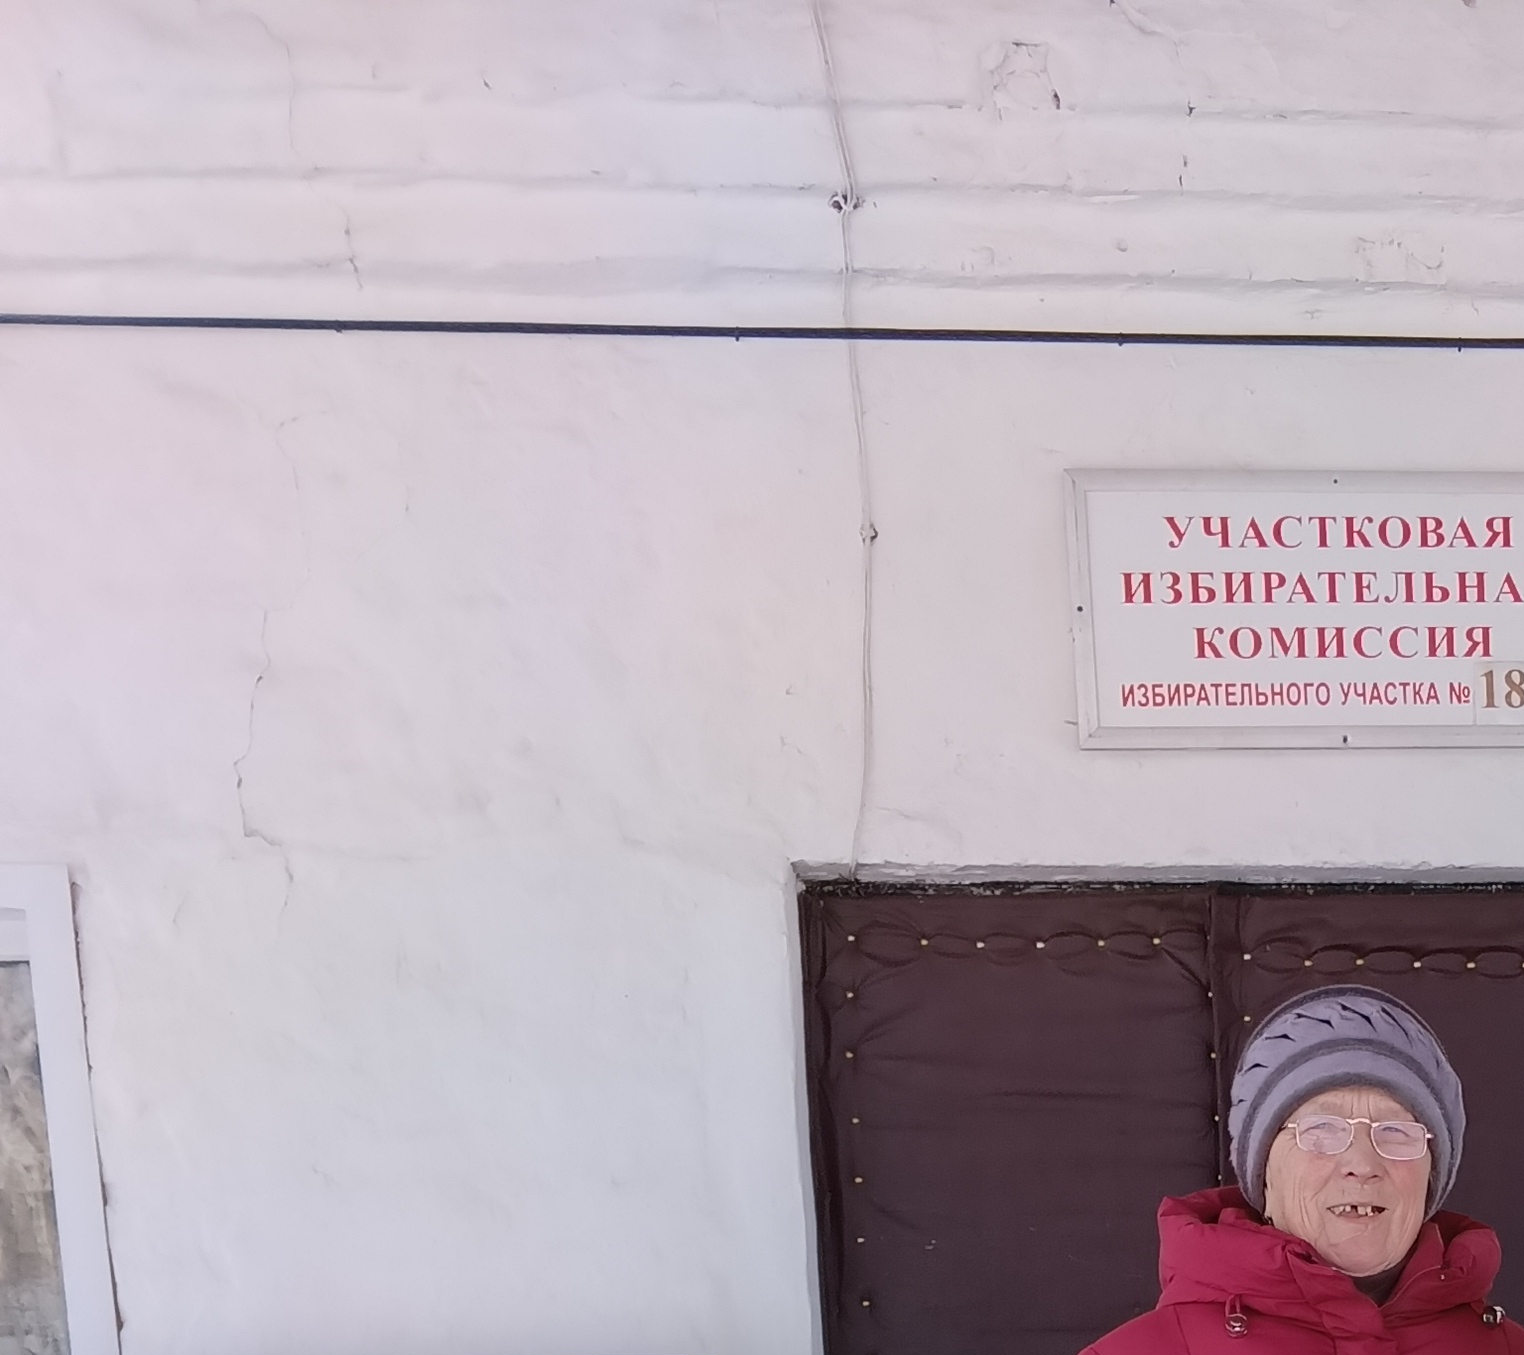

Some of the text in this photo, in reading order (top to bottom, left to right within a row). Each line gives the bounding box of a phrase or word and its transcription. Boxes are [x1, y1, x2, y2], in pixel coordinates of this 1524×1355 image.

[1162, 516, 1514, 549] УЧАСТКОВАЯ
[1193, 626, 1493, 659] КОМИССИЯ
[1121, 682, 1331, 708] ИЗБИРАТЕЛЬНОГО
[1340, 682, 1440, 705] УЧАСТКА
[1448, 682, 1471, 704] №
